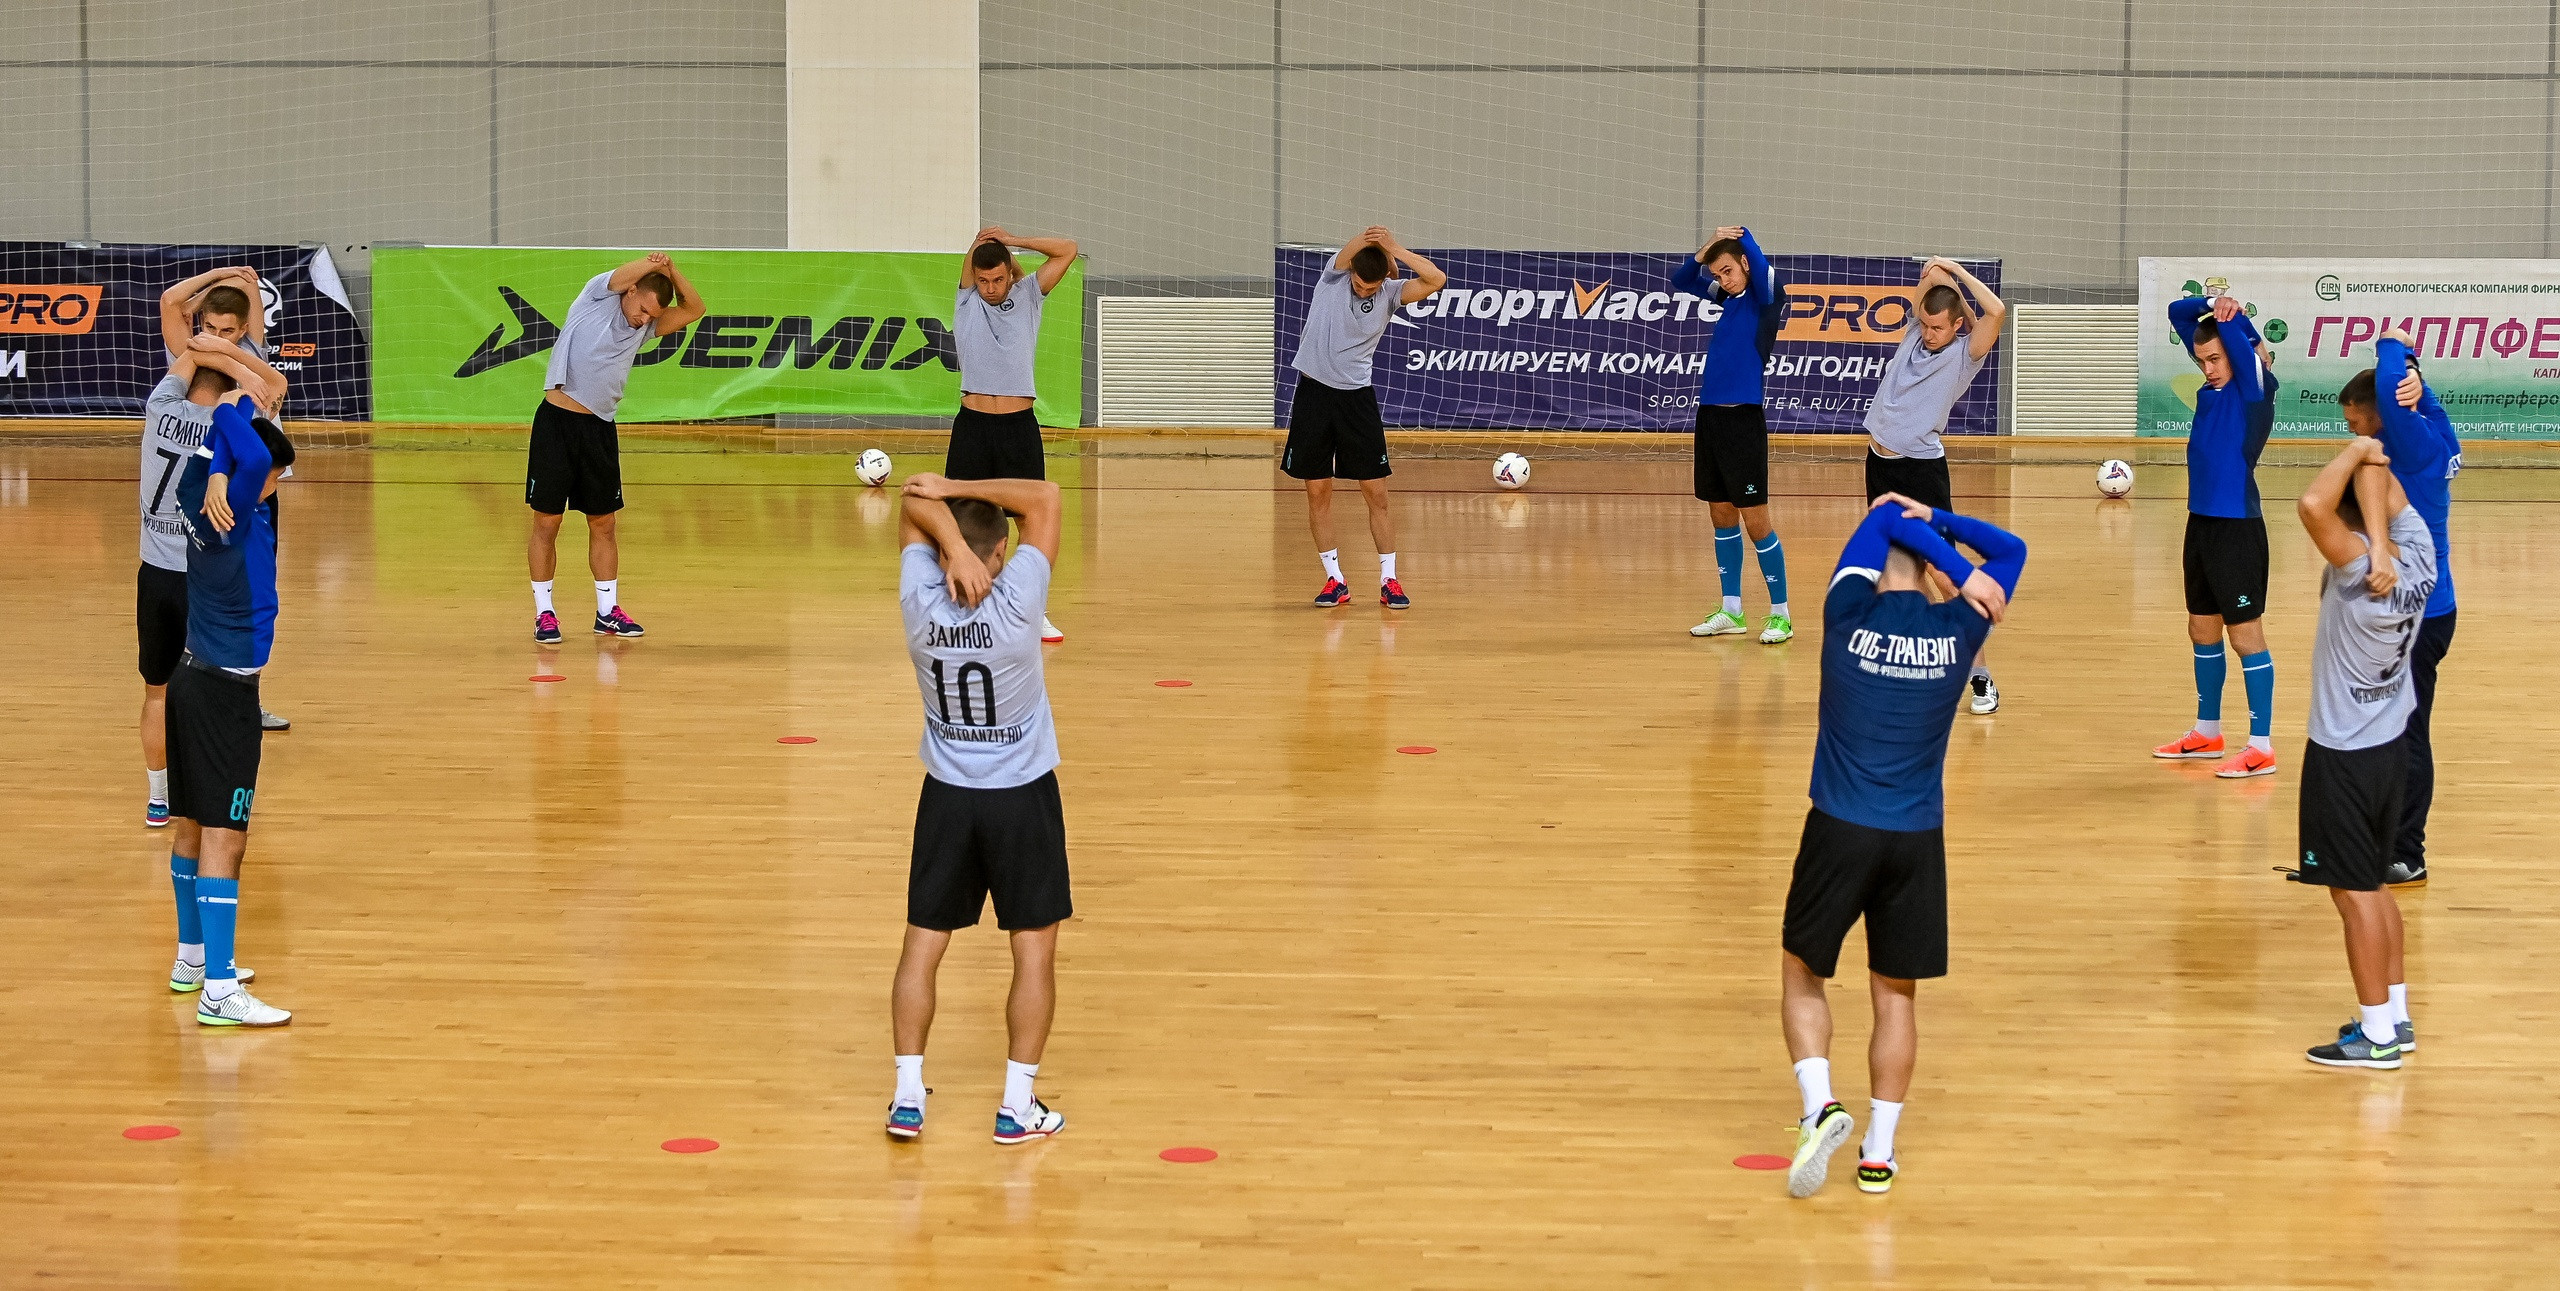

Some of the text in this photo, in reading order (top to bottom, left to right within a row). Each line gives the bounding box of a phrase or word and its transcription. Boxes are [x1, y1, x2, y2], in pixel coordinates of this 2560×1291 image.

[2346, 284, 2560, 293] БИОТЕХНОЛОГИЧЕСКАЯ КОМПАНИЯ ФИРН
[1779, 295, 1913, 333] PRO
[1405, 349, 1591, 373] ЭКИПИРУЕМ
[1598, 352, 1708, 375] КОМАН
[150, 447, 181, 515] 7
[1848, 629, 1957, 666] СИБ-ТРАНЗИТ
[931, 659, 996, 727] 10
[230, 788, 254, 822] 89
